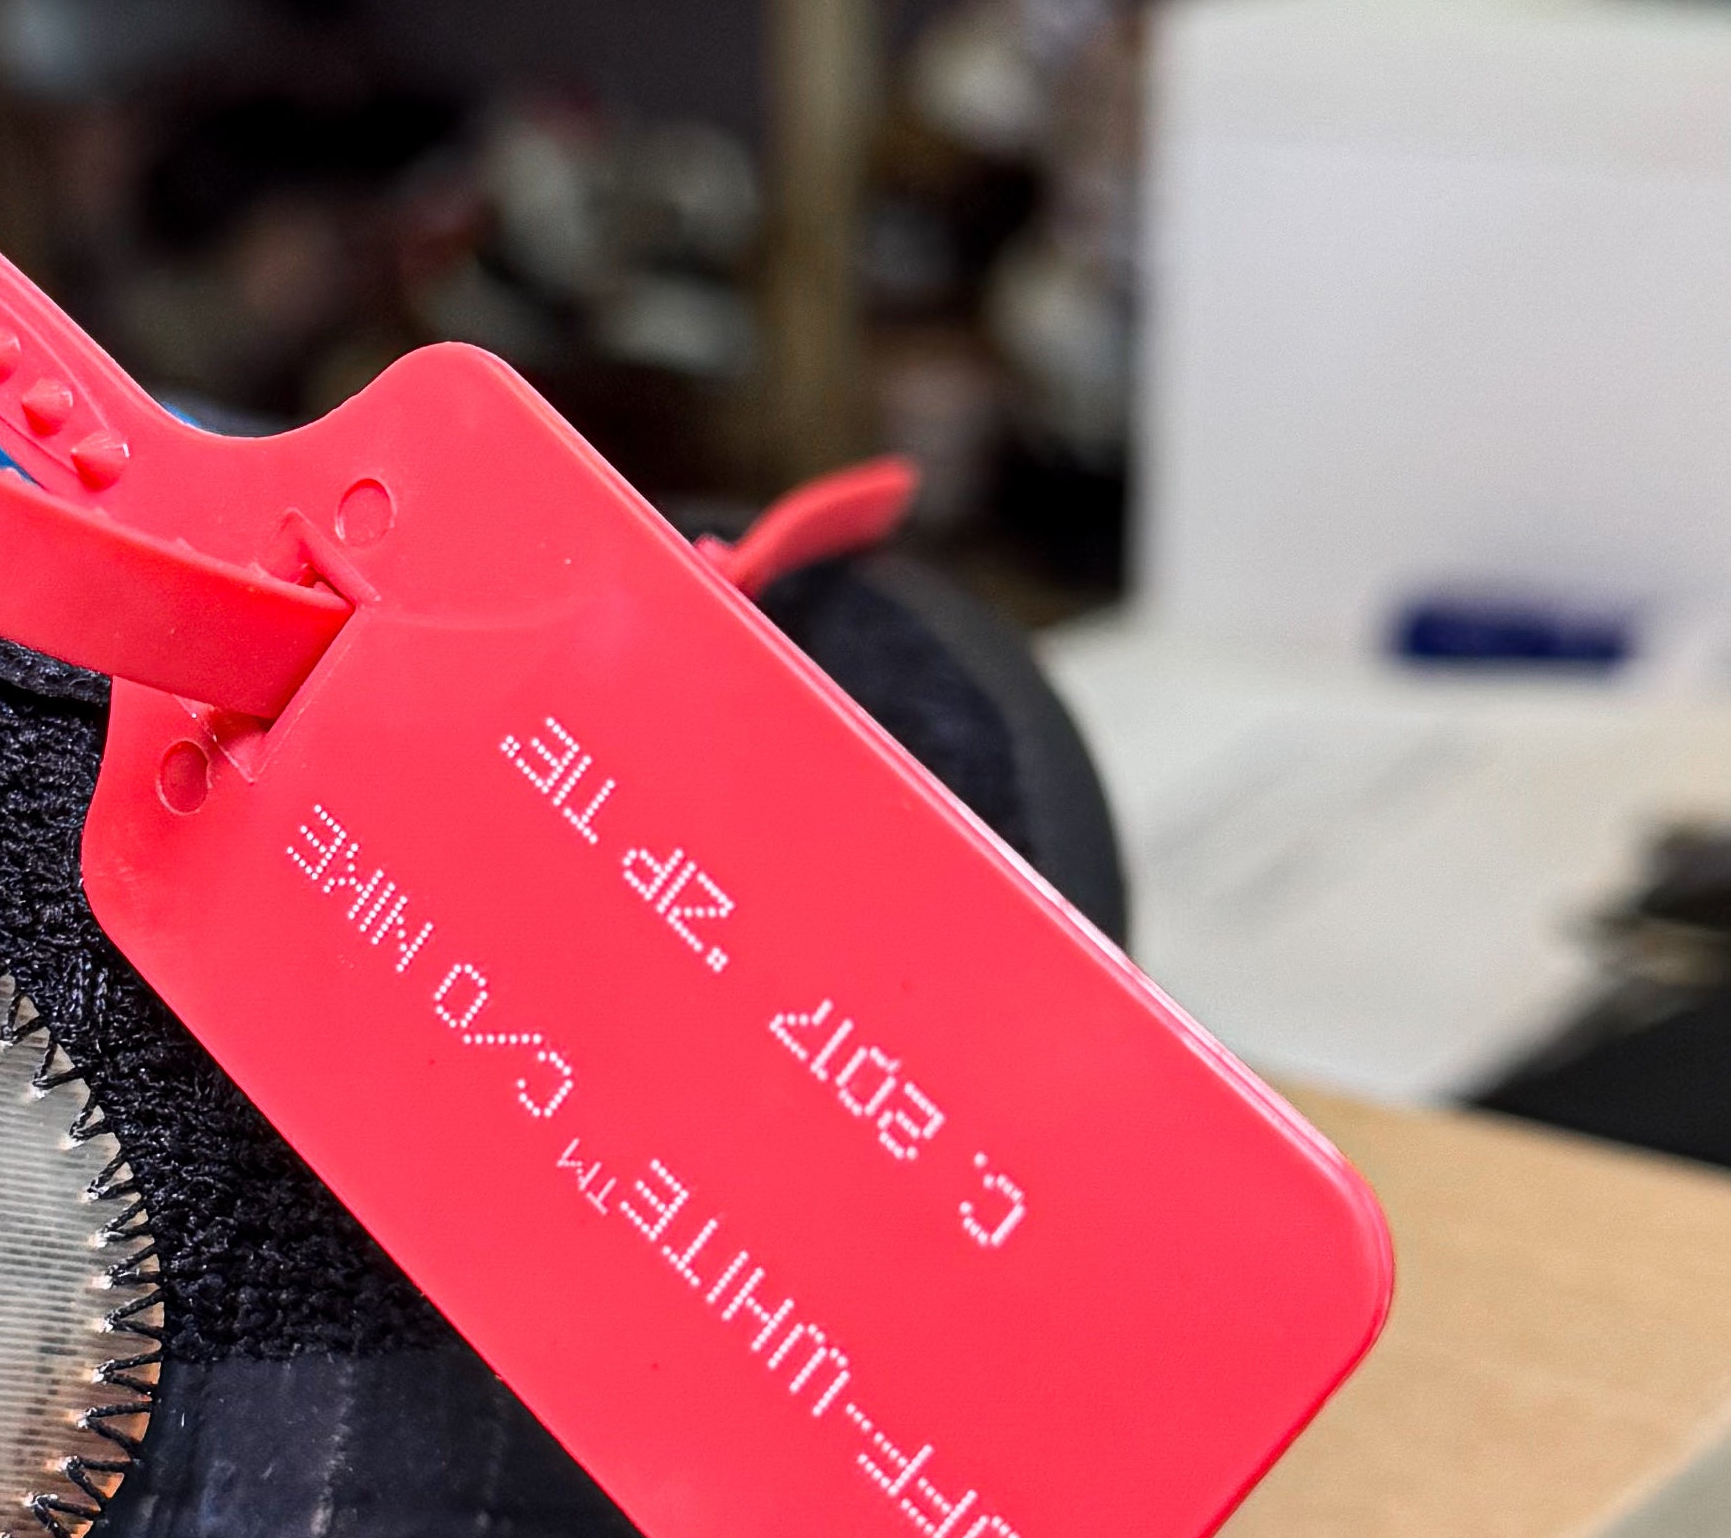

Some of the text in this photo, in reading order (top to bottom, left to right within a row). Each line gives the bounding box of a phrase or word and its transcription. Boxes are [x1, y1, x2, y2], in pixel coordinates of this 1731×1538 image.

[286, 804, 434, 973] NIKE
[433, 963, 575, 1118] C/O
[768, 999, 945, 1161] 2017
[959, 1152, 1026, 1248] C.
